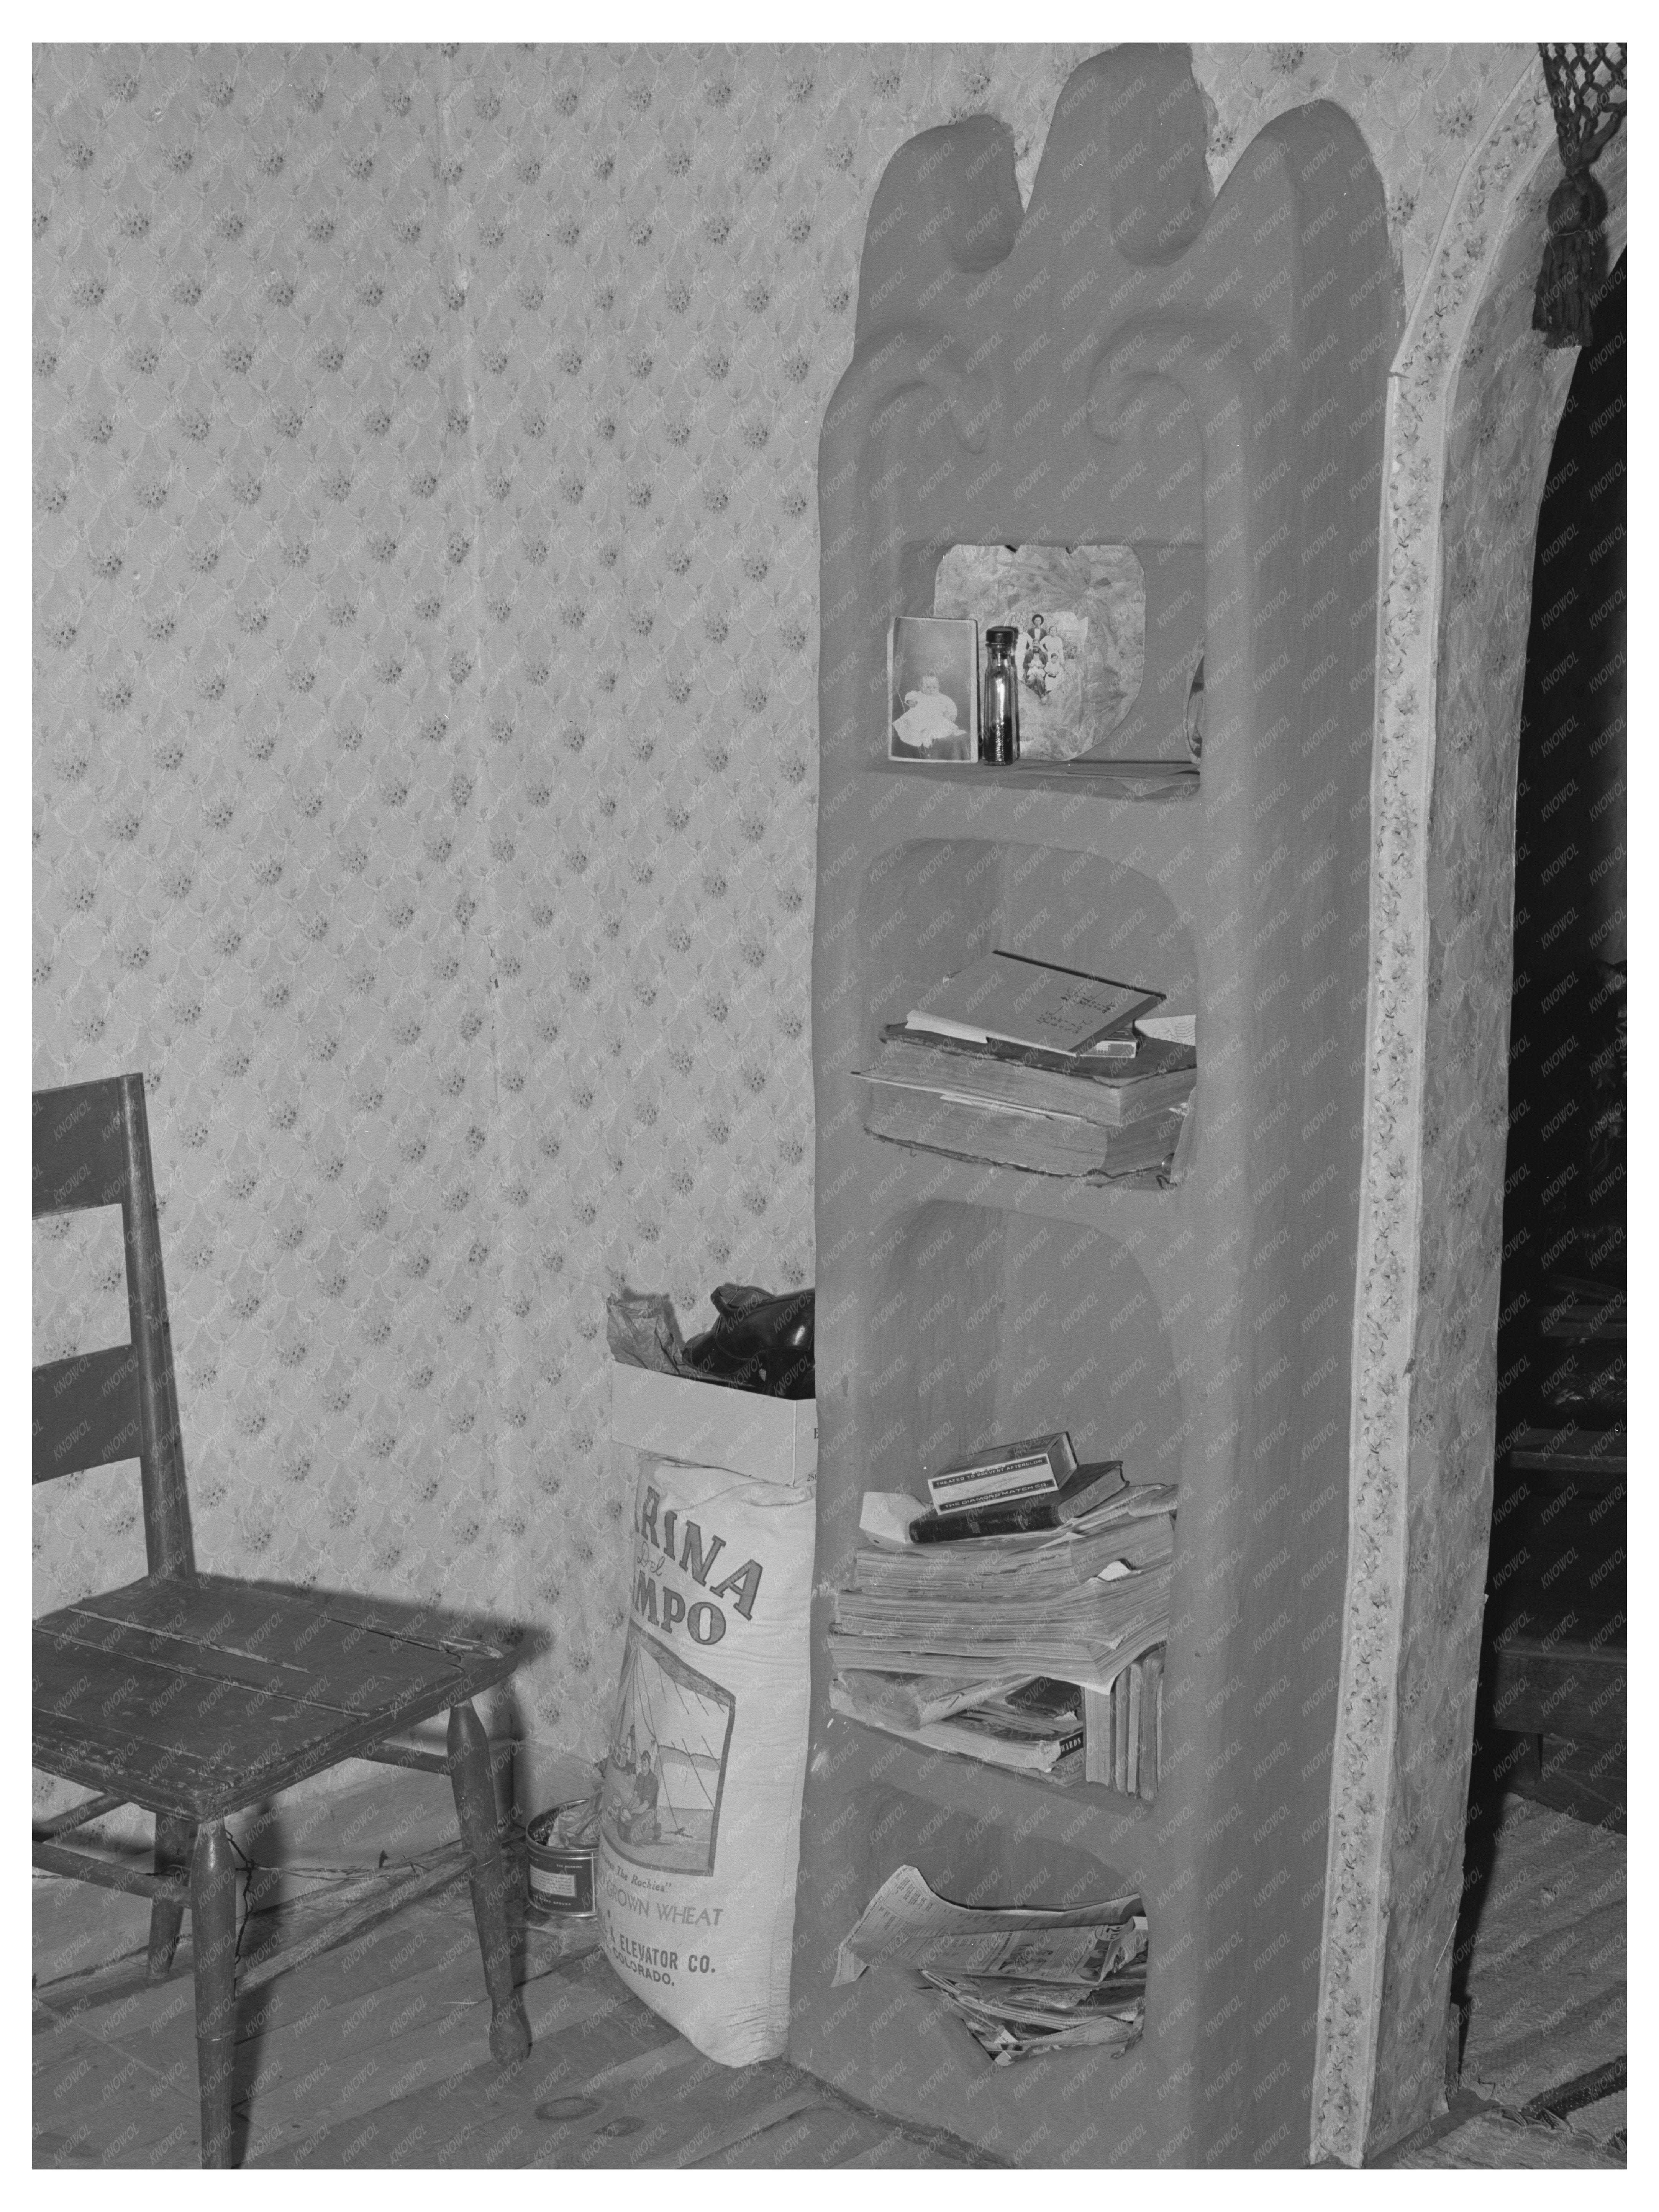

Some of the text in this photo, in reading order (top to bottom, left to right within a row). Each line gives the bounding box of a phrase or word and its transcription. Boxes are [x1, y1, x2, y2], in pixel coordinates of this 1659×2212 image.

[936, 1477, 964, 1486] TREATED
[977, 1468, 1004, 1477] PREVENT
[1007, 1459, 1043, 1470] AFTERGLOW
[962, 1493, 1000, 1504] DIAMOND
[1002, 1485, 1034, 1495] MATCH
[635, 1486, 763, 1621] RINA
[637, 1540, 666, 1576] Del
[633, 1569, 726, 1645] MPO
[617, 1865, 628, 1881] The
[656, 1902, 724, 1927] WHEAT
[613, 1946, 675, 1986] COLORADO.
[620, 1933, 678, 1970] ELEVATOR
[688, 1954, 716, 1973] CO.
